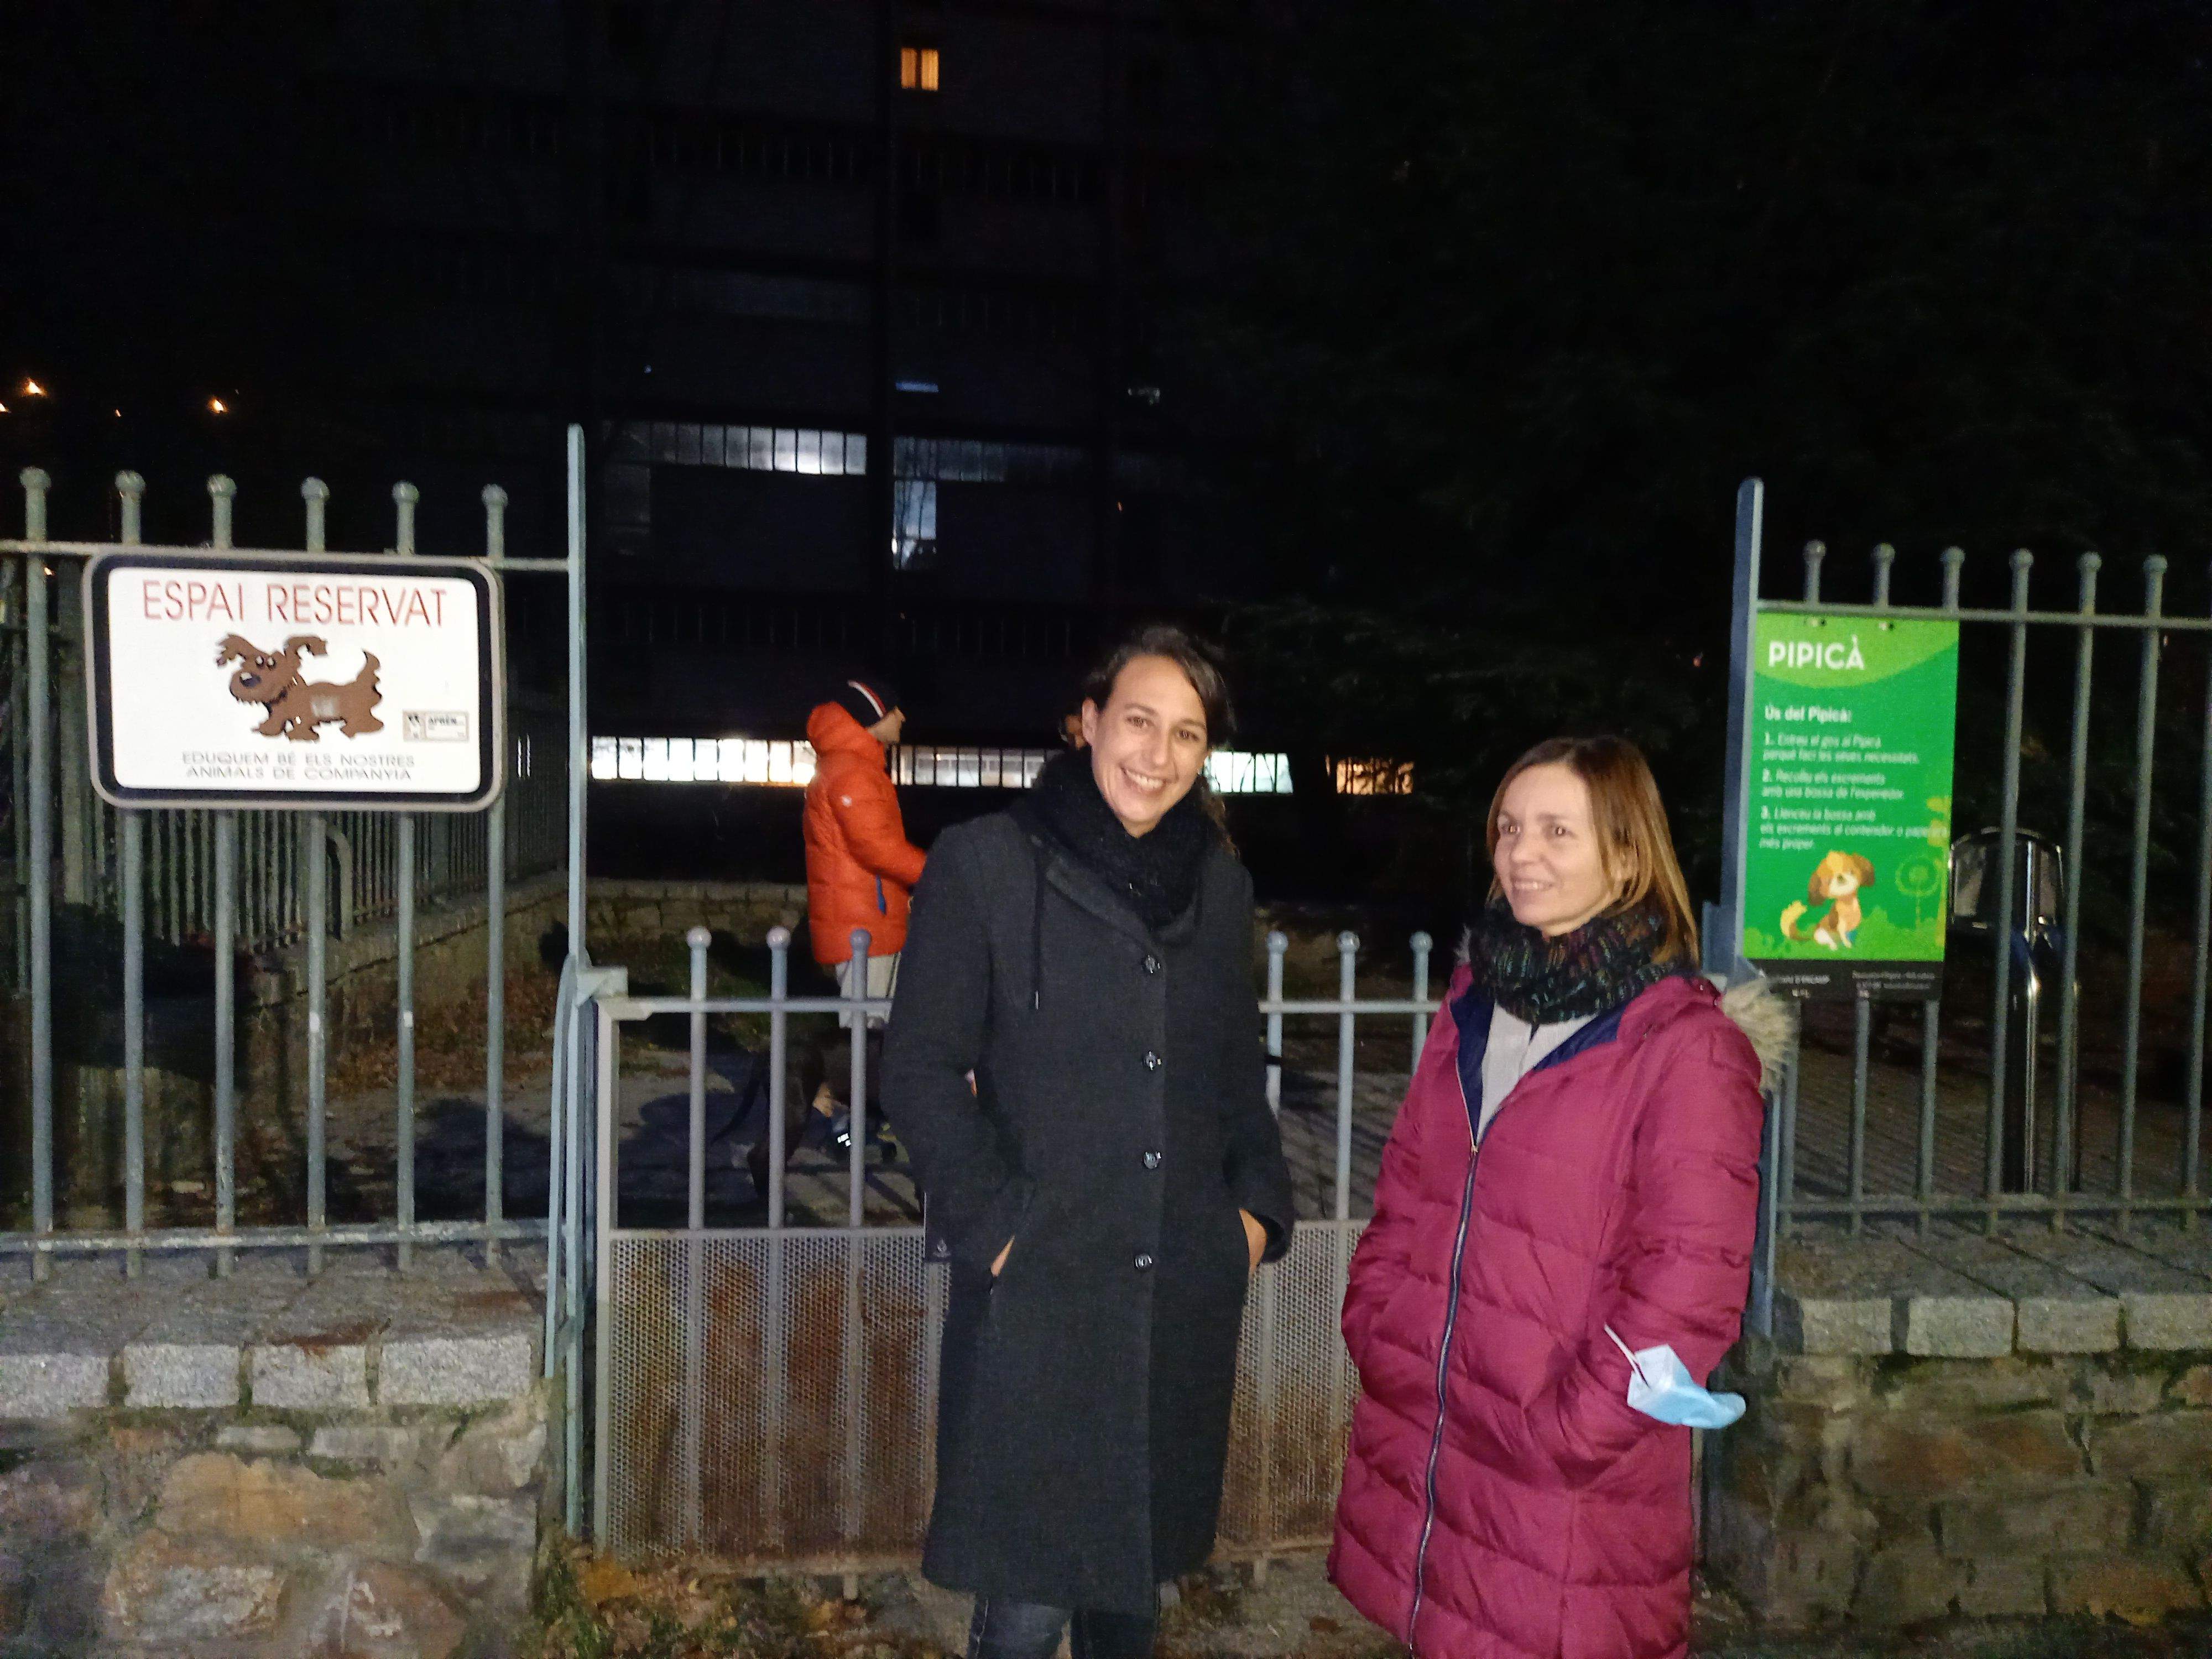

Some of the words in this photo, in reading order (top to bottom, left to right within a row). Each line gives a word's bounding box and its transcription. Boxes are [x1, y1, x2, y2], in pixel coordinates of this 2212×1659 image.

[143, 580, 244, 621] ESPAI
[267, 583, 447, 627] RESERVAT
[1770, 635, 1865, 670] PIPICÀ
[1785, 706, 1804, 721] del
[182, 751, 269, 764] EDUQUEM
[305, 753, 333, 766] ELS
[341, 754, 415, 768] NOSTRES
[186, 766, 264, 779] ANIMALS
[273, 767, 296, 780] DE
[305, 768, 412, 781] COMPANYIA
